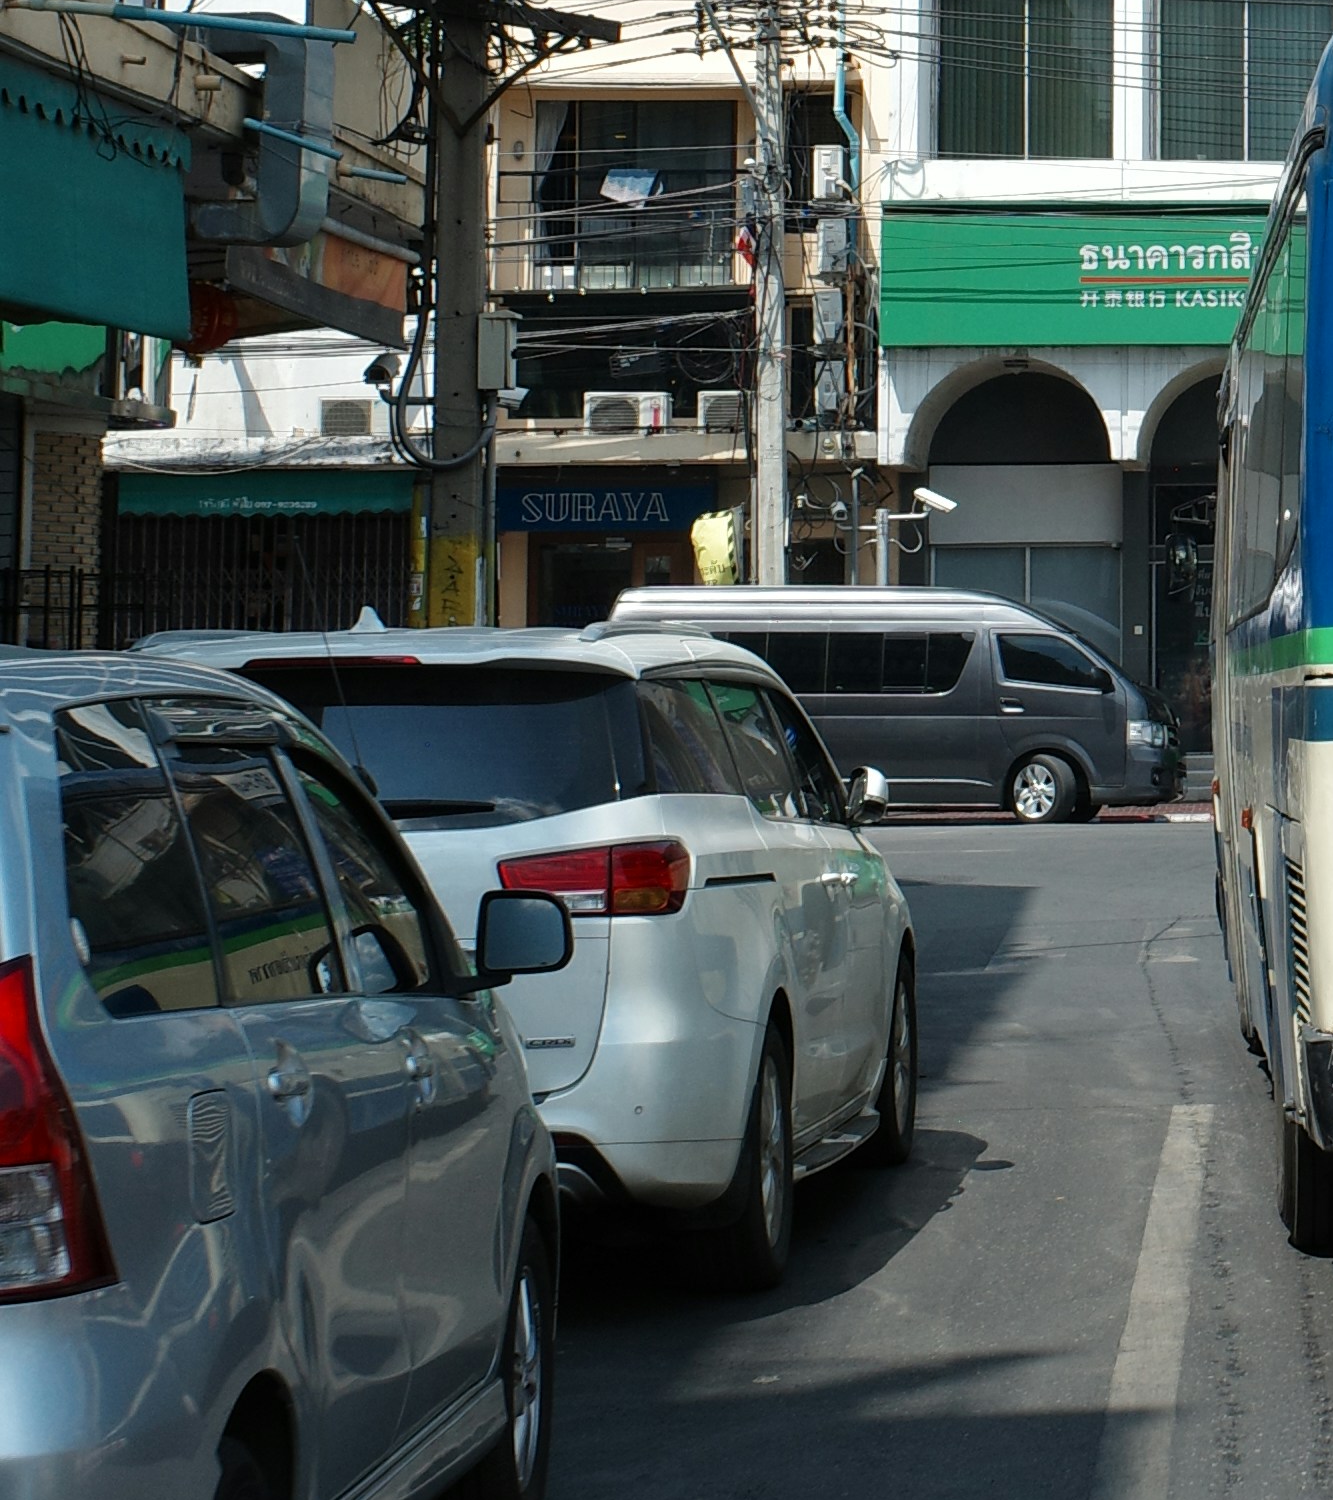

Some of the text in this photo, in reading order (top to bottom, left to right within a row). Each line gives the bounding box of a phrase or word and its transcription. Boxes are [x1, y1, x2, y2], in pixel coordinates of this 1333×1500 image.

[1079, 230, 1260, 271] ธนาคารกสิ
[1175, 290, 1247, 308] KASIK
[521, 492, 670, 523] SURAYA
